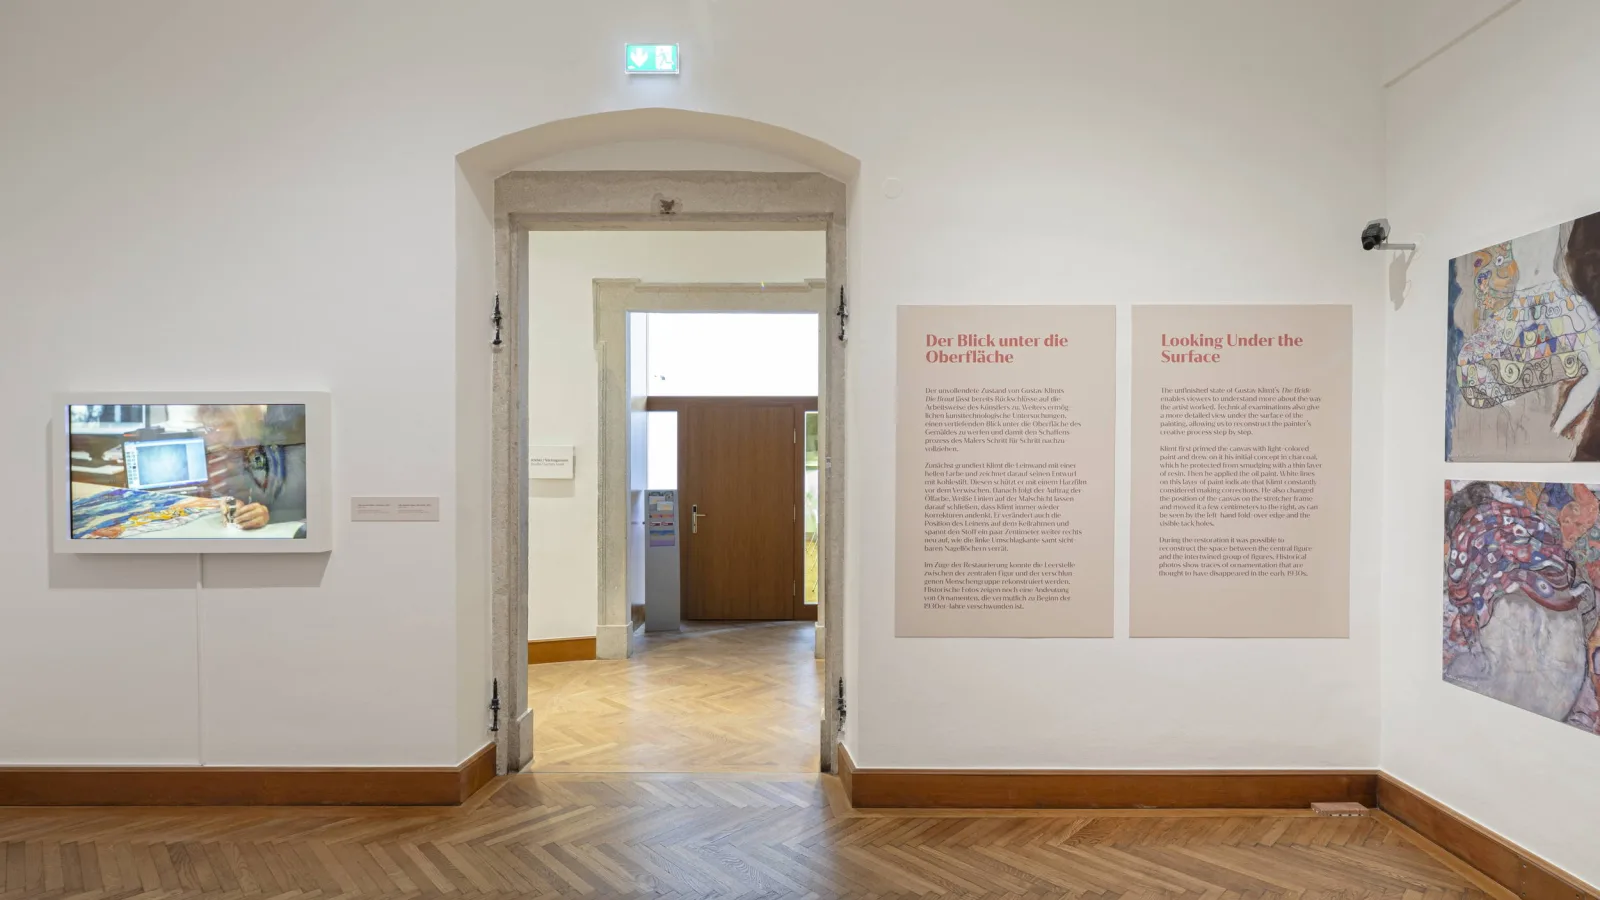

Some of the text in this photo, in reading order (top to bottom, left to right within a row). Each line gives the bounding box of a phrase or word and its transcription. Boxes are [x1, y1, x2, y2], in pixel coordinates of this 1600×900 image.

[926, 334, 1068, 347] Der Blick unter die
[1162, 334, 1304, 349] Looking Under the
[926, 350, 1014, 364] Oberfläche
[1161, 350, 1220, 363] Surface
[1189, 420, 1216, 428] allowing
[1214, 428, 1227, 436] step
[1193, 445, 1217, 453] primed
[955, 462, 984, 470] grundiert
[1214, 470, 1238, 478] applied
[1018, 487, 1032, 495] folgt
[1047, 487, 1069, 495] Auftrag
[1197, 486, 1220, 495] making
[1287, 486, 1314, 495] changed
[1294, 545, 1312, 553] figure
[998, 570, 1014, 578] Figur
[946, 578, 1001, 586] Menschengruppe
